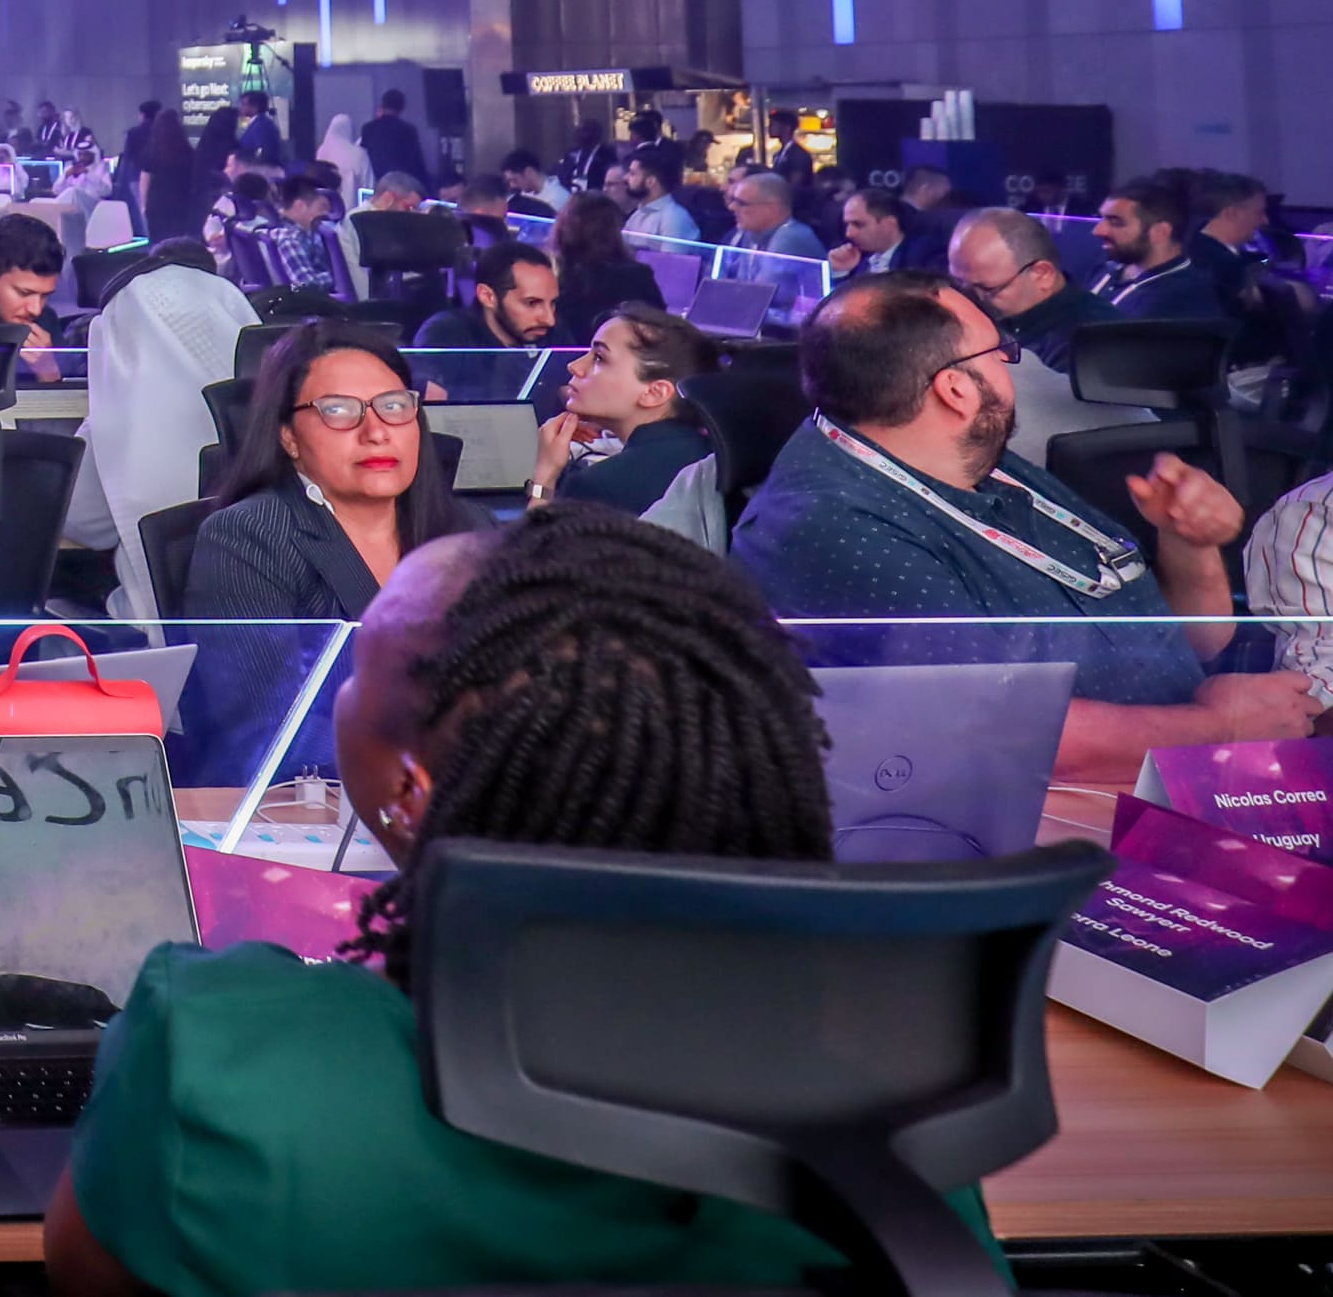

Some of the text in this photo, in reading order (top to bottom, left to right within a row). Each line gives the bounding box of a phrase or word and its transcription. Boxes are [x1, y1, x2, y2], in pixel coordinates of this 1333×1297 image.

[532, 72, 624, 93] COFFEE PLANET
[1214, 789, 1327, 809] Nicolas Correa
[1099, 880, 1275, 951] hmond Redwood
[1106, 897, 1191, 933] Sawyerr
[1070, 912, 1173, 958] erra Leone
